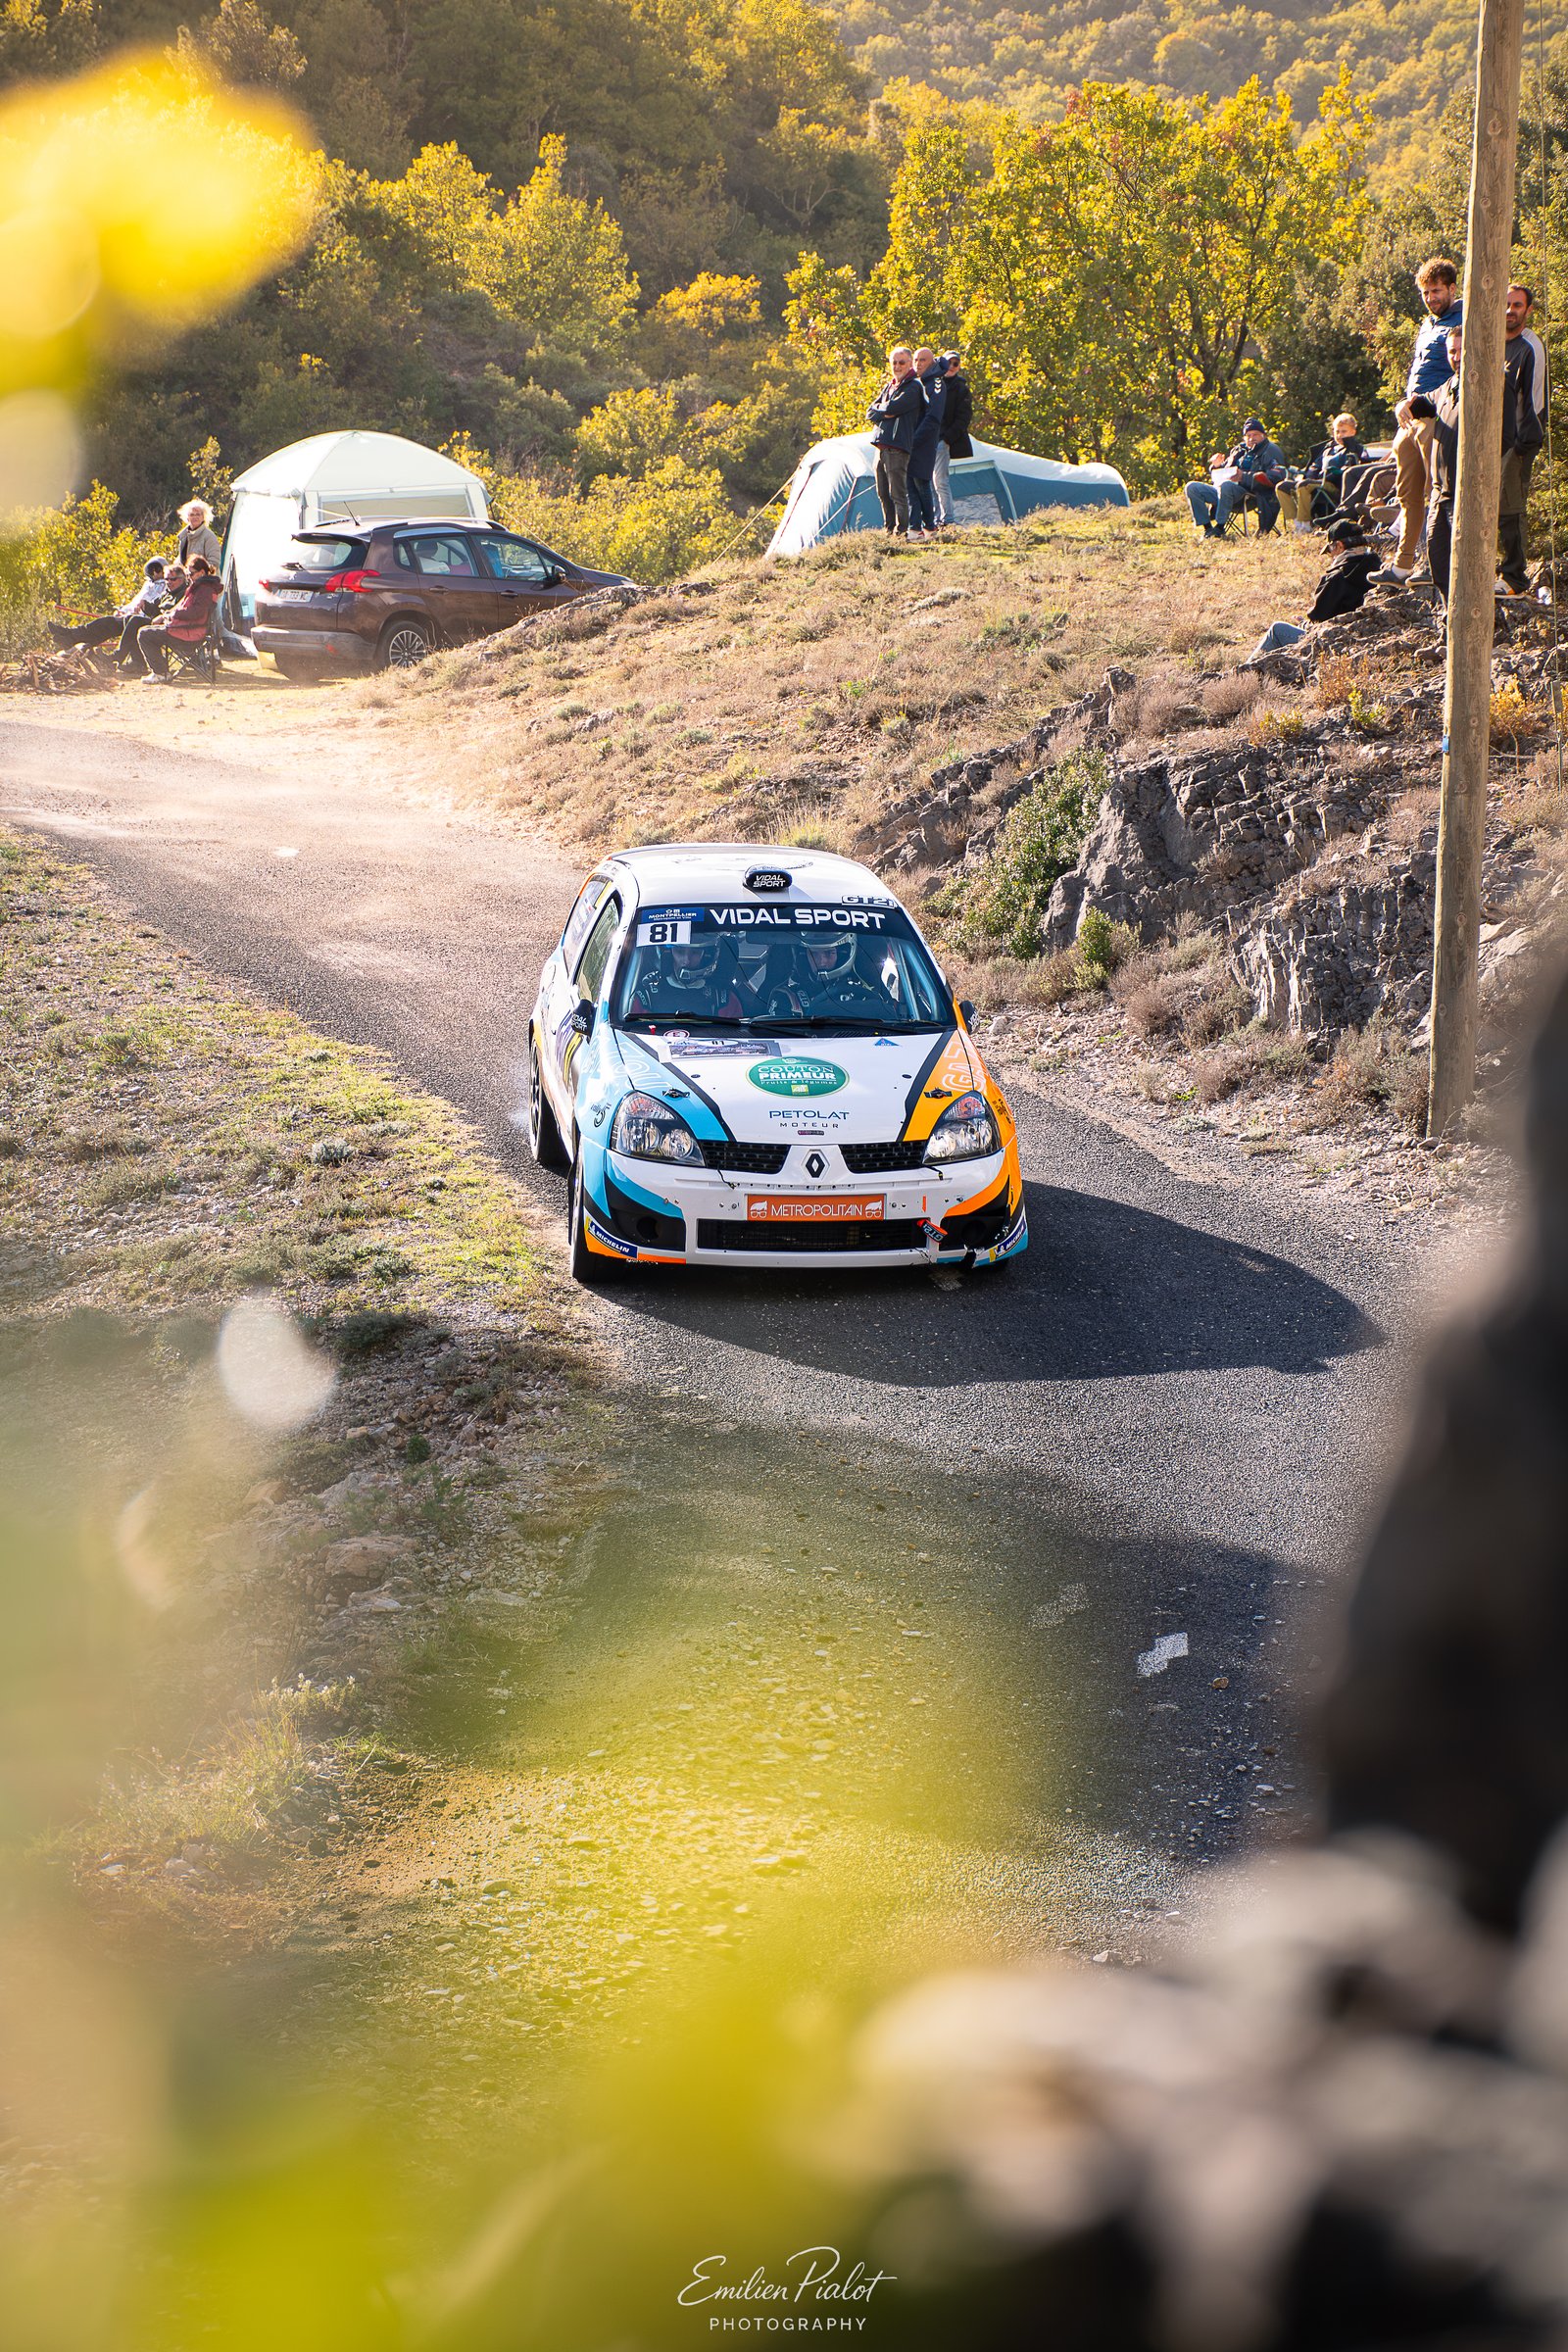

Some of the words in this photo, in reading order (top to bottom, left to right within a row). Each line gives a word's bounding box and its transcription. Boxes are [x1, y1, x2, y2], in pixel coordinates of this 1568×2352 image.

[710, 908, 791, 925] VIDAL
[796, 909, 886, 929] SPORT
[649, 922, 678, 943] 81
[769, 1110, 850, 1120] PETOLAT
[771, 1203, 863, 1216] METROPOLITAIN
[596, 1231, 630, 1253] MICHELIN
